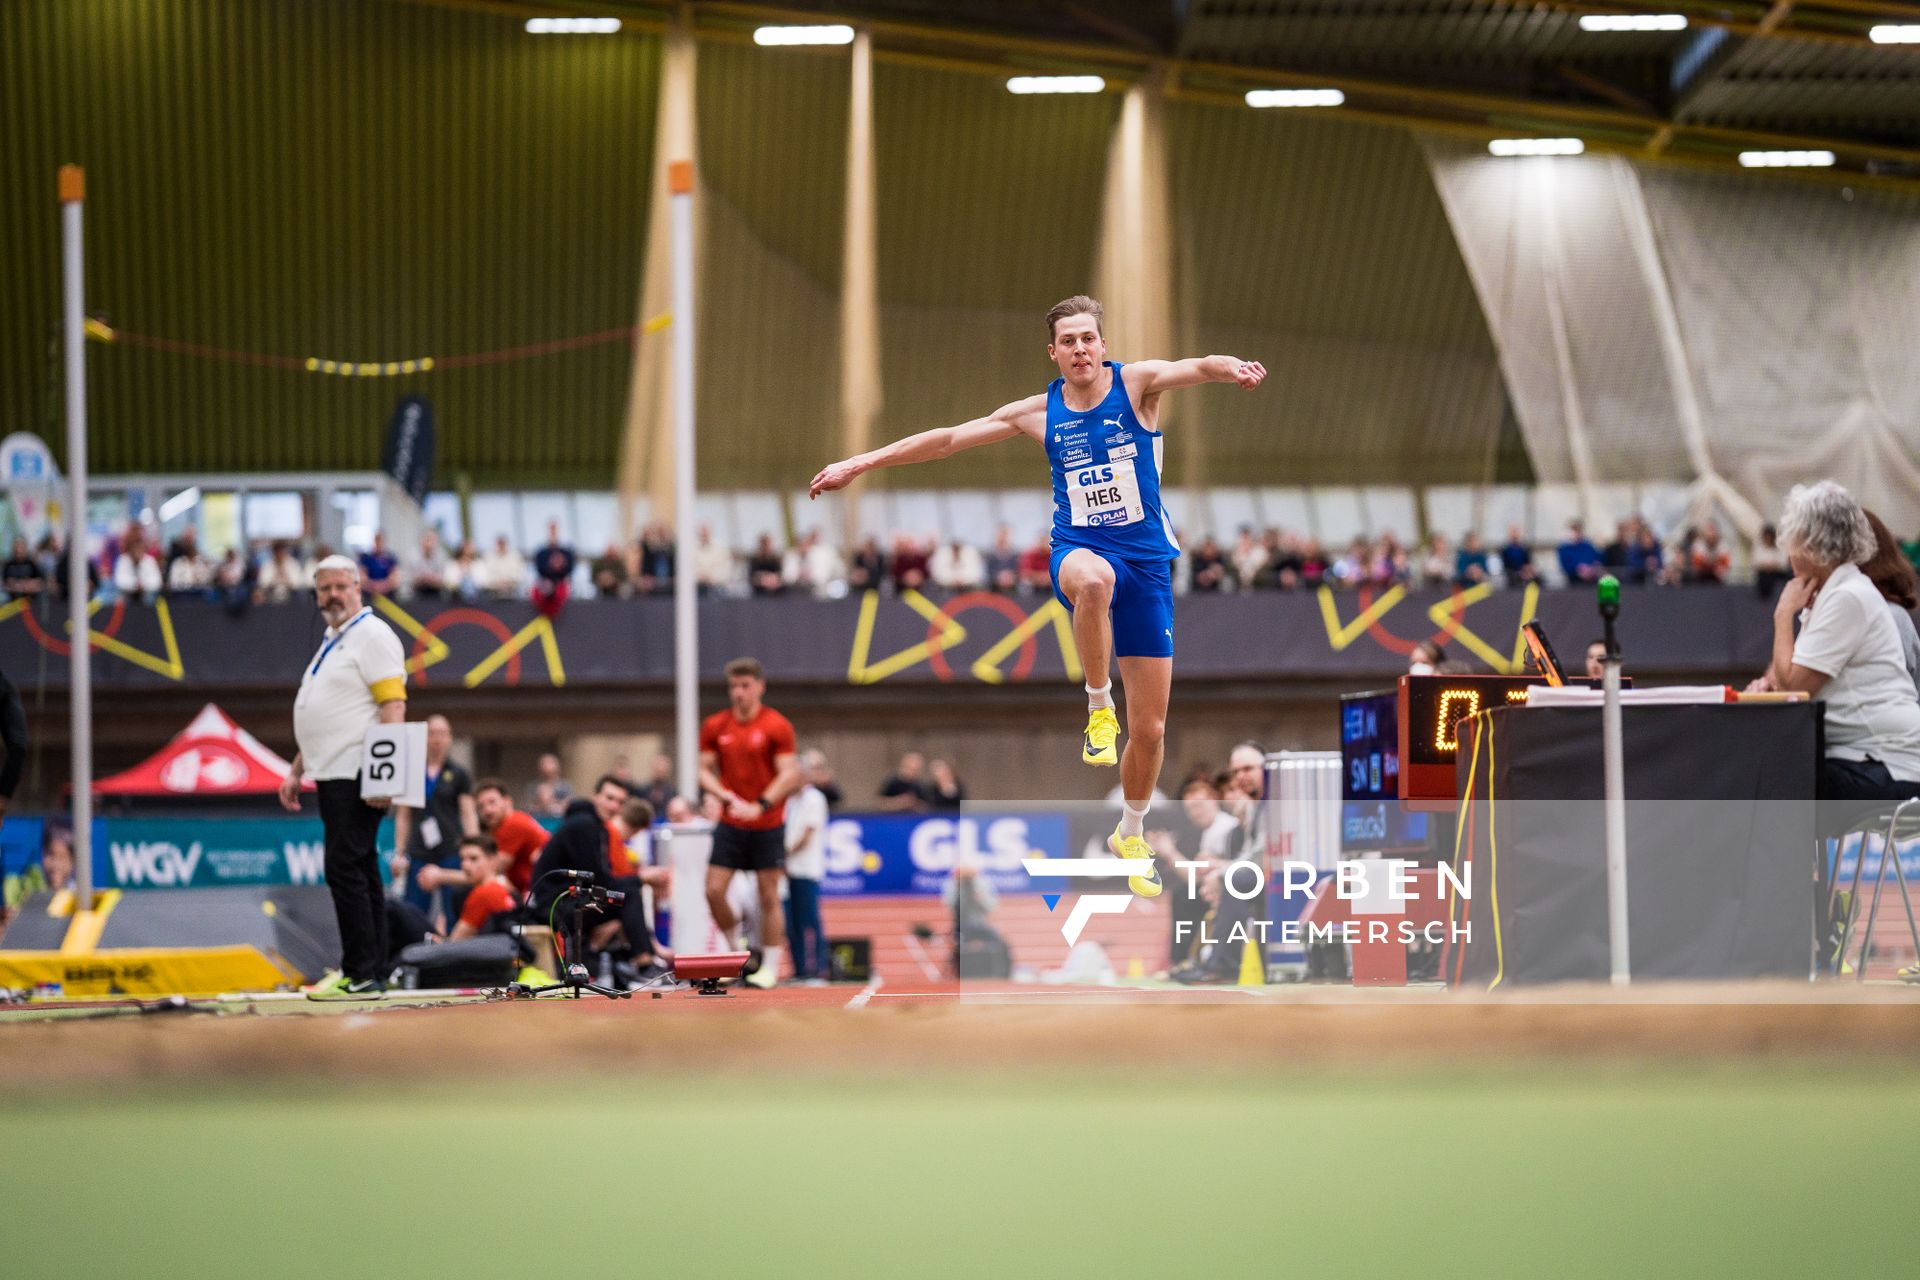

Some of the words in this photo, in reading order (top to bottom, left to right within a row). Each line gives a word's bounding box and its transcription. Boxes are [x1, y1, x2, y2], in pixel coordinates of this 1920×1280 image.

[1103, 510, 1126, 521] PLAN
[370, 740, 396, 781] 50
[110, 841, 202, 886] WGV
